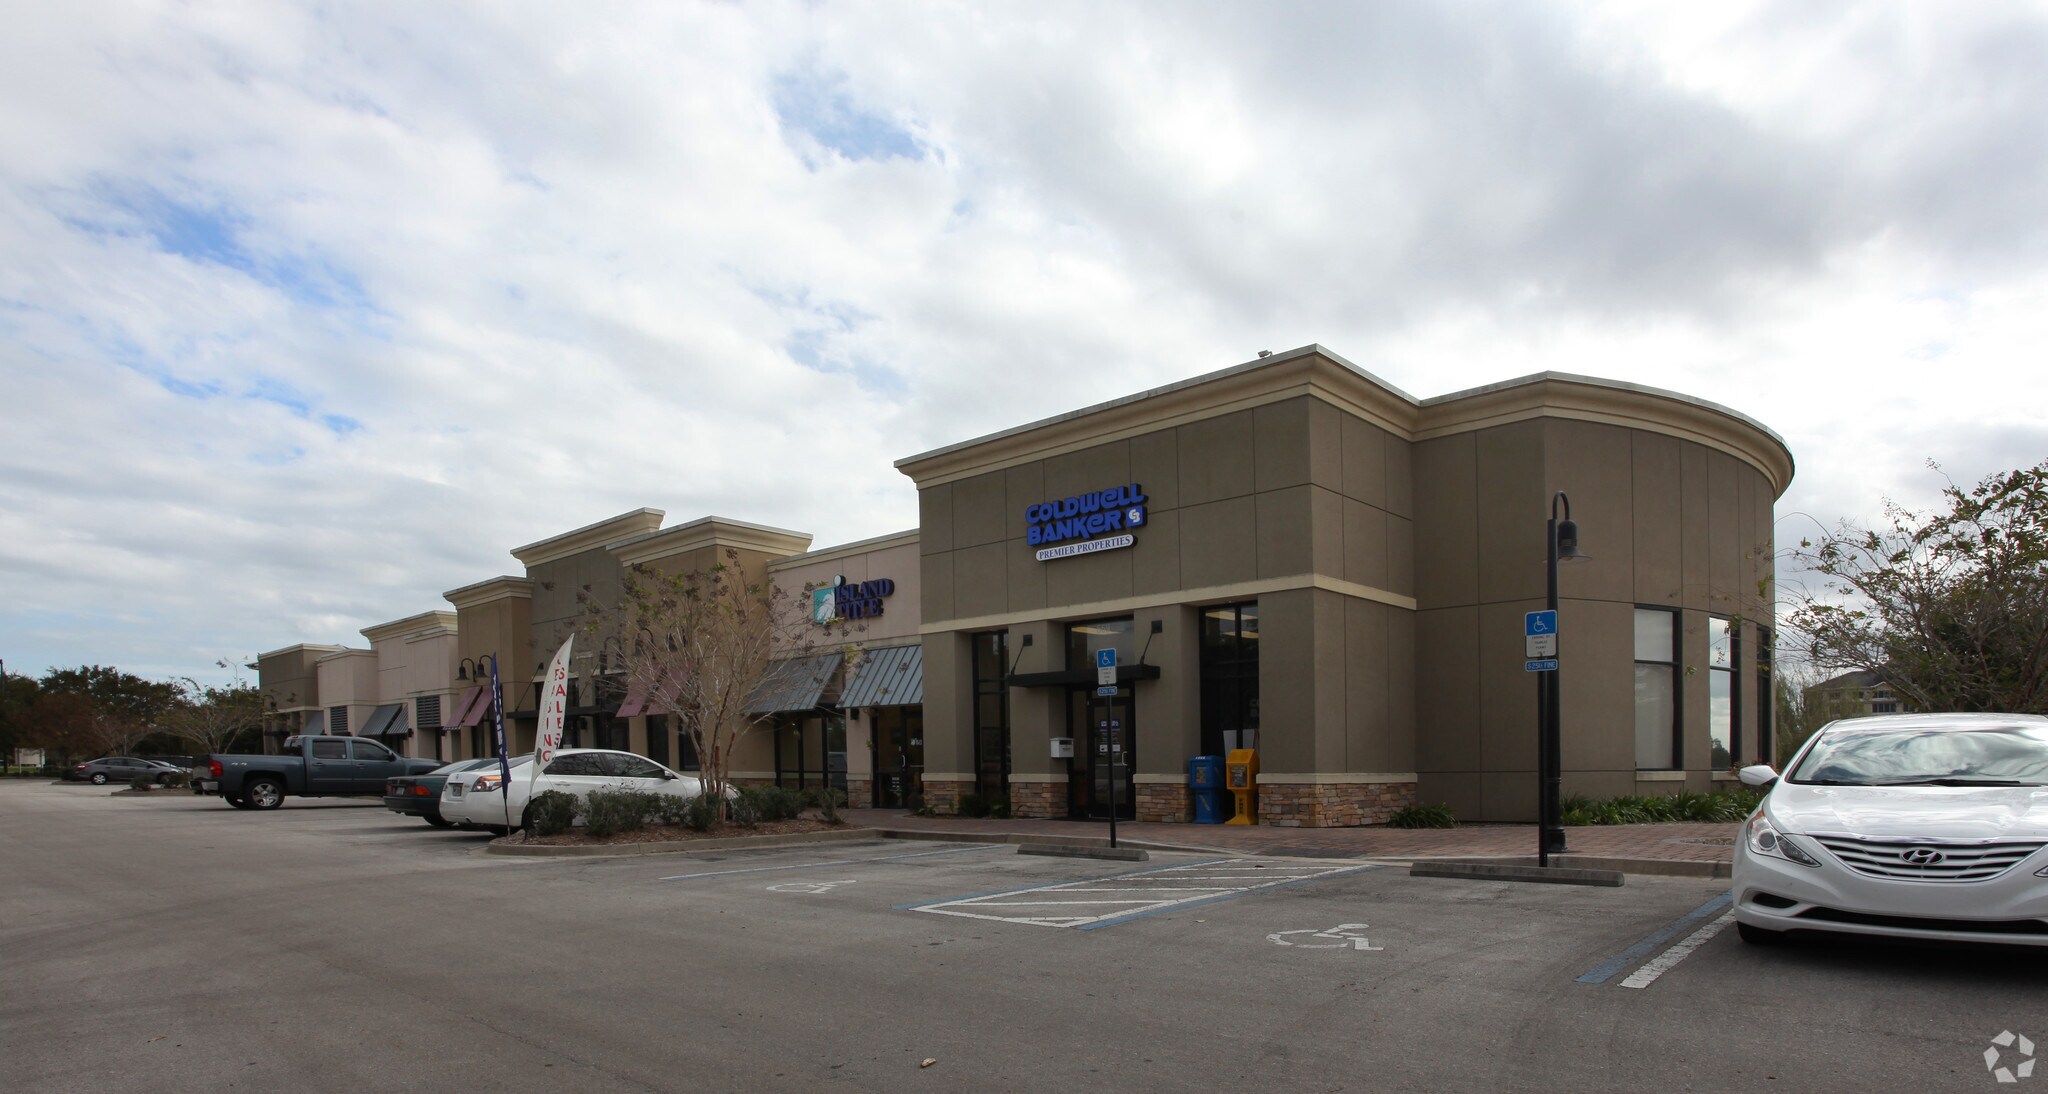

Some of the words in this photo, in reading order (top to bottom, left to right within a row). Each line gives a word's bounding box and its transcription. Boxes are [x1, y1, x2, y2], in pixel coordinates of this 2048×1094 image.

[1026, 483, 1145, 524] COLDWELL
[1027, 509, 1122, 545] BANKER
[1039, 545, 1075, 560] PREMIER
[1077, 535, 1131, 553] PROPERTIES
[834, 577, 893, 602] ISLAND
[835, 598, 880, 620] TITLE
